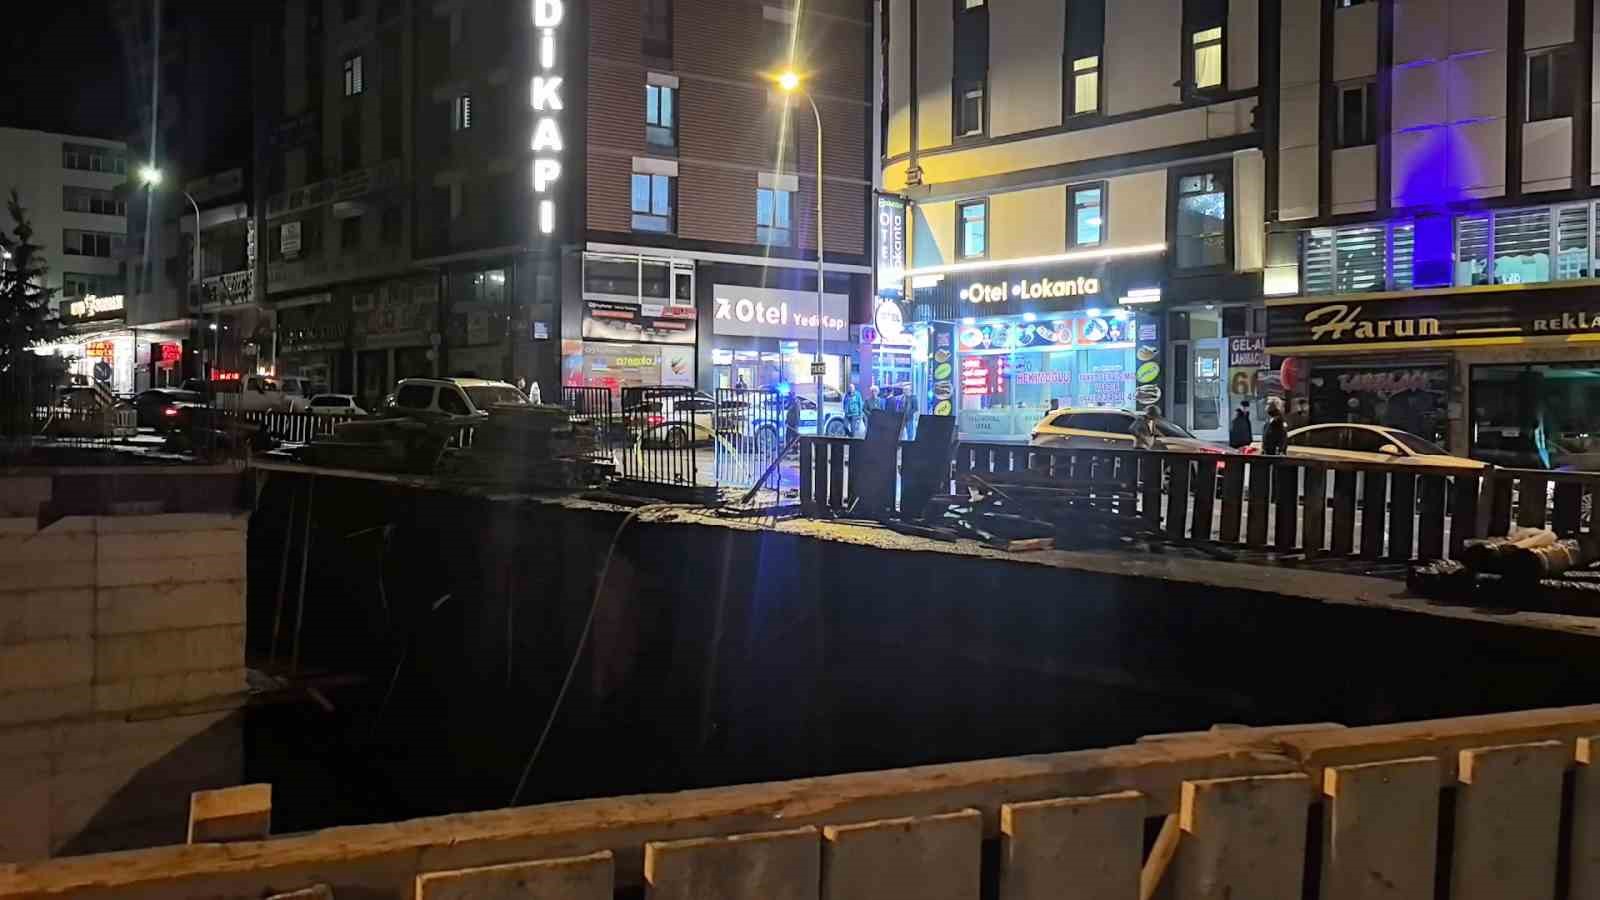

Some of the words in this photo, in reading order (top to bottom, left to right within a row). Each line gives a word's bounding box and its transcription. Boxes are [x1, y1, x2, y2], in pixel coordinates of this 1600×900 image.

[968, 281, 1008, 304] Otel
[1021, 275, 1098, 300] Lokanta
[735, 298, 788, 326] Otel
[1306, 304, 1441, 341] Harun
[1533, 311, 1600, 332] REKLA
